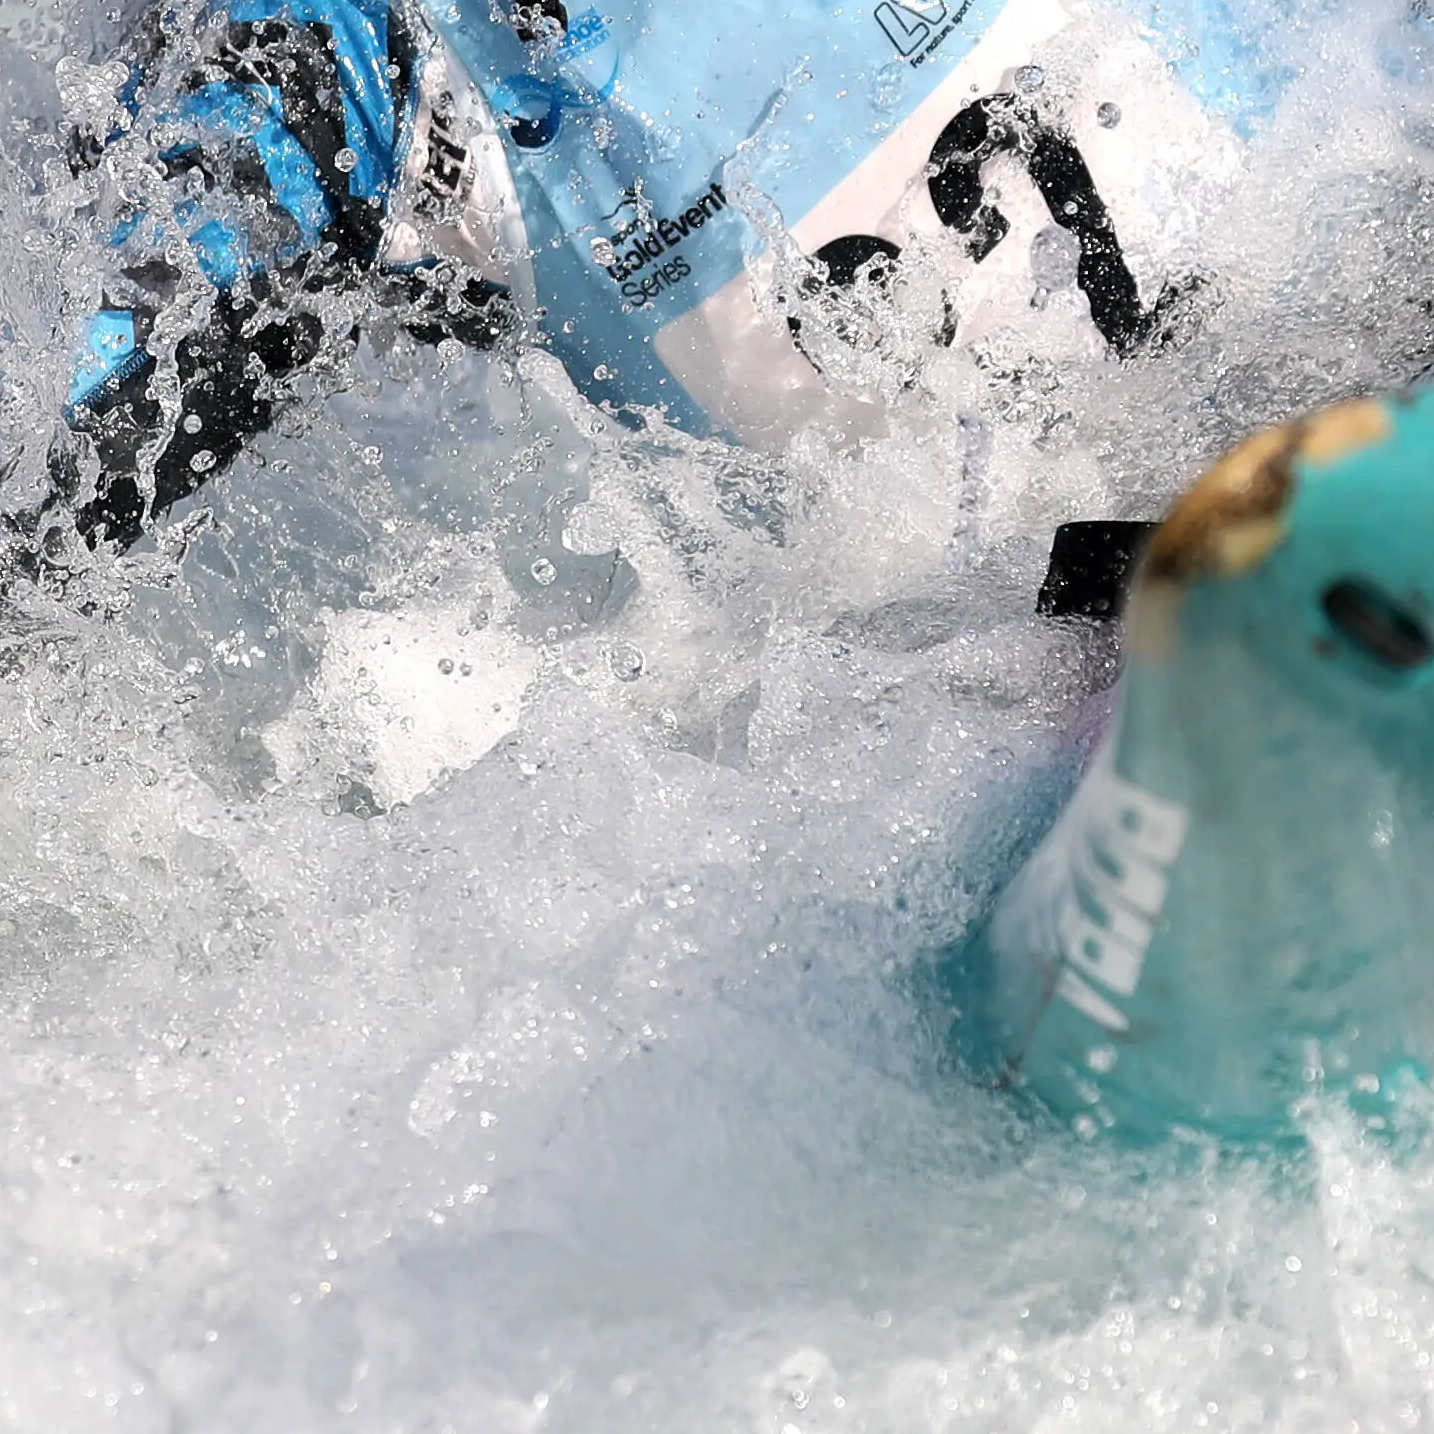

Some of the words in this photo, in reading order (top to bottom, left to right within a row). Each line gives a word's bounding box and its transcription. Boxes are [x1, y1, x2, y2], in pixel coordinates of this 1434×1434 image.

[909, 52, 927, 68] For
[951, 0, 972, 25] sport
[606, 232, 666, 282] Gold
[657, 182, 729, 247] Event
[621, 255, 692, 307] Series
